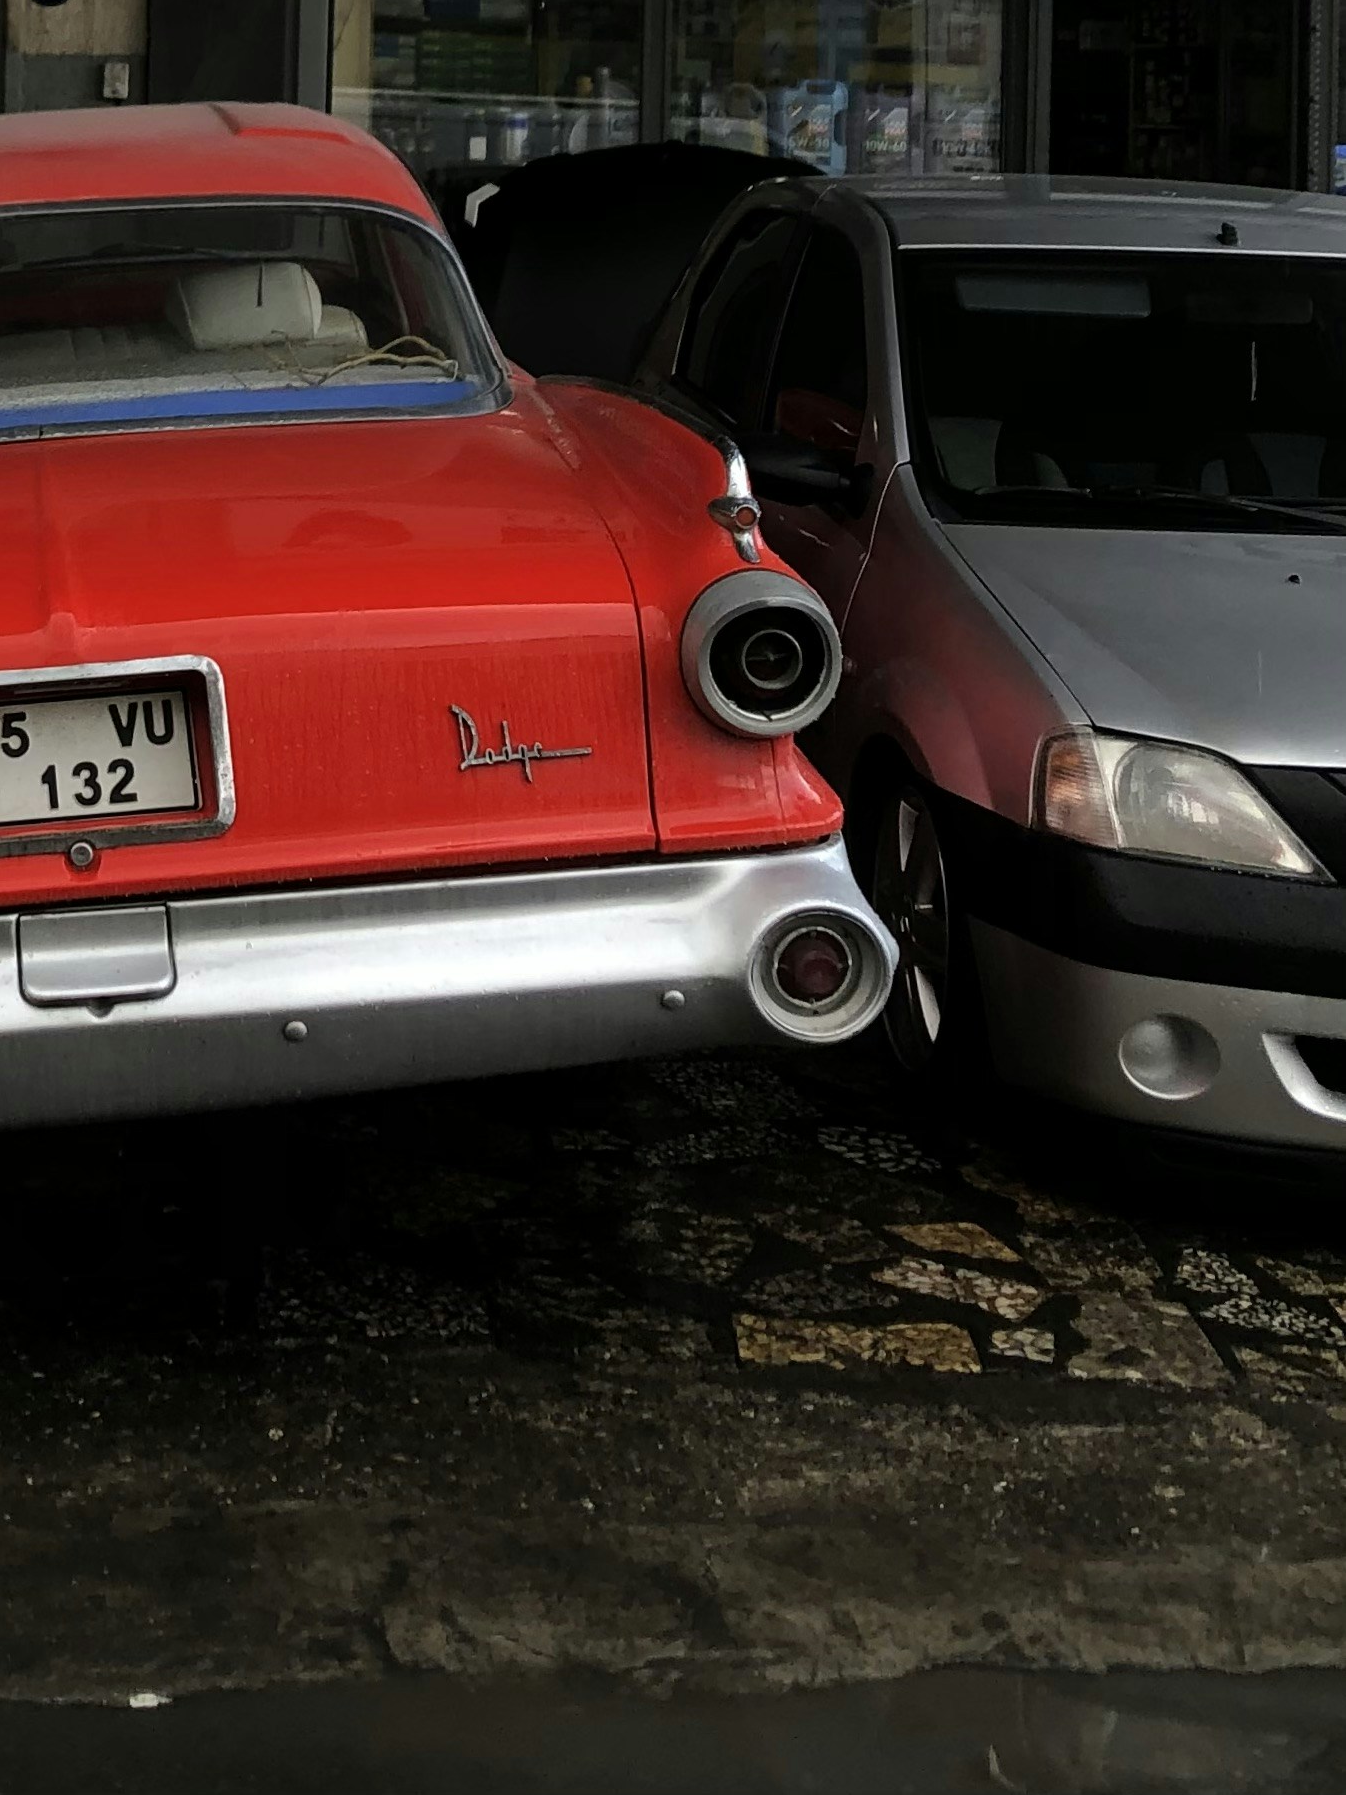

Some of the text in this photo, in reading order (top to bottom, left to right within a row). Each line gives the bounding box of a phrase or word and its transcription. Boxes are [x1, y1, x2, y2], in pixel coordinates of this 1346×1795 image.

[109, 698, 175, 747] VU
[451, 704, 592, 783] Dodge
[41, 758, 138, 811] 132
